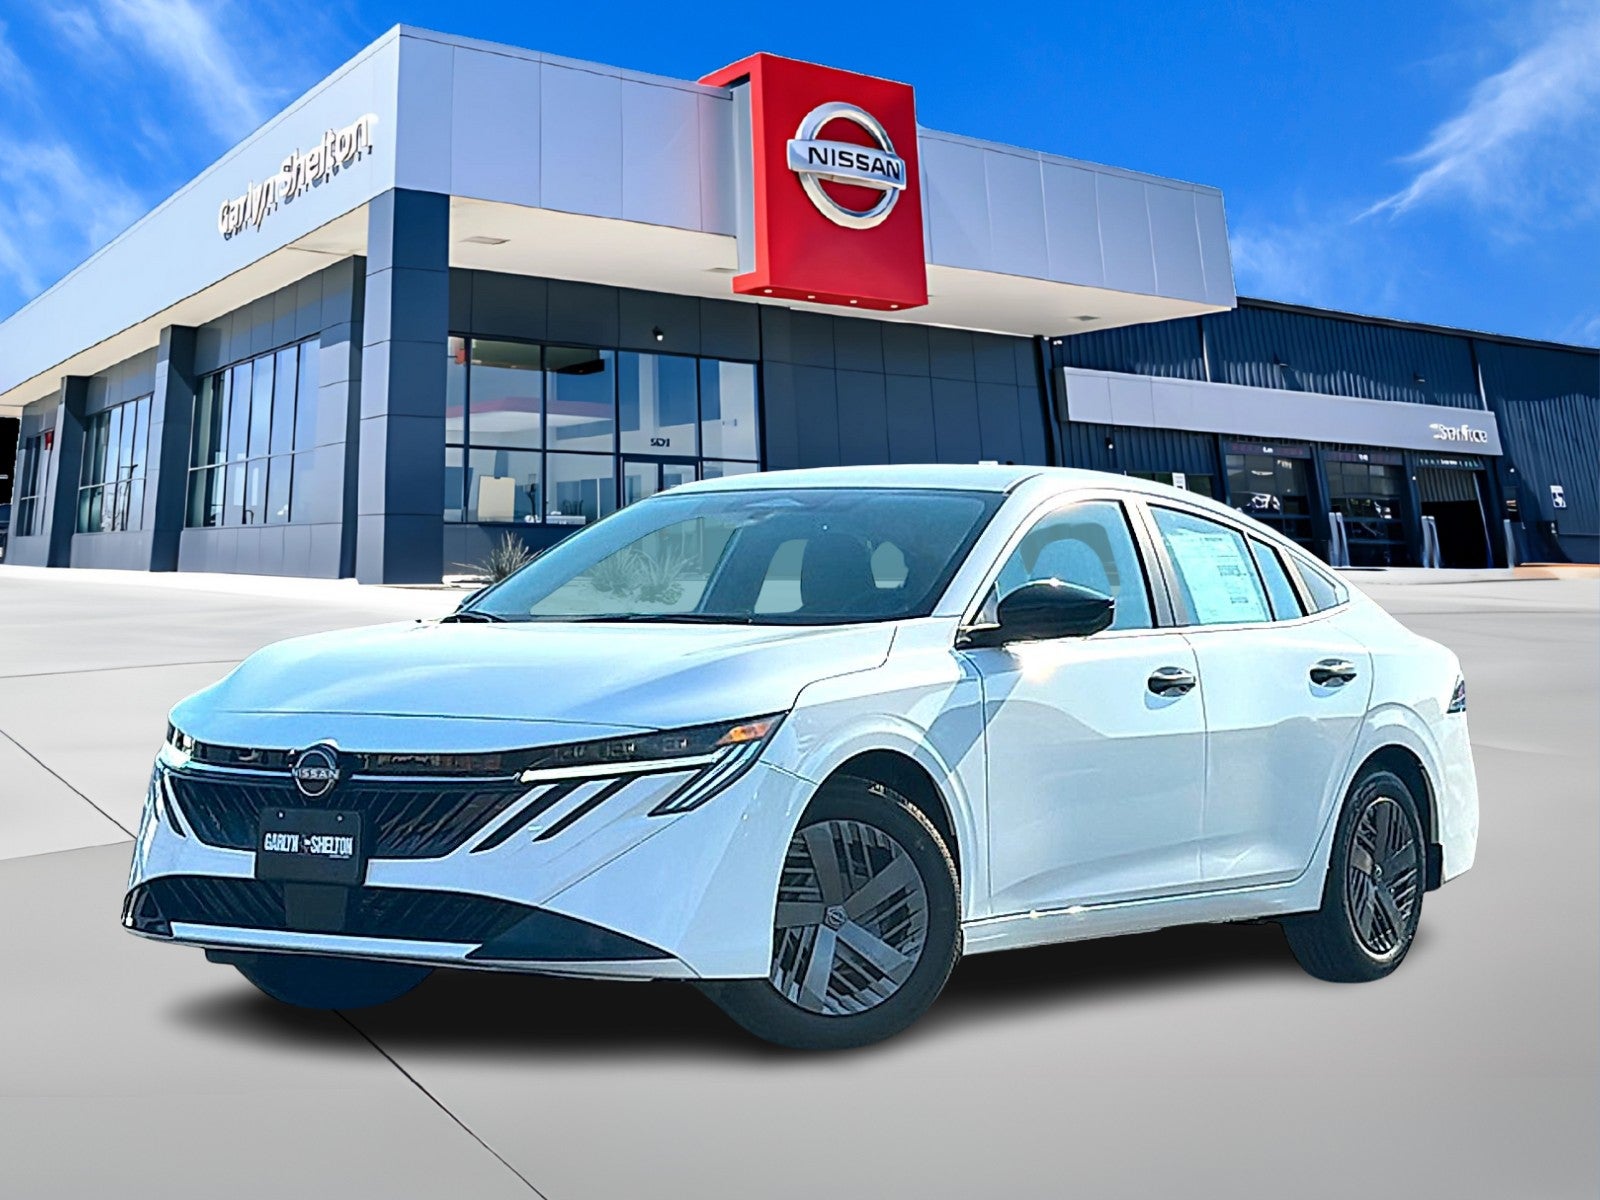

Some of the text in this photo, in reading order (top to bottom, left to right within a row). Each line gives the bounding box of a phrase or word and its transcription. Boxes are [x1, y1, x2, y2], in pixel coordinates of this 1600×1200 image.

[278, 115, 373, 202] Shelton
[808, 146, 901, 180] NISSAN
[292, 767, 340, 780] NISSAN
[310, 835, 353, 856] SHELTON
